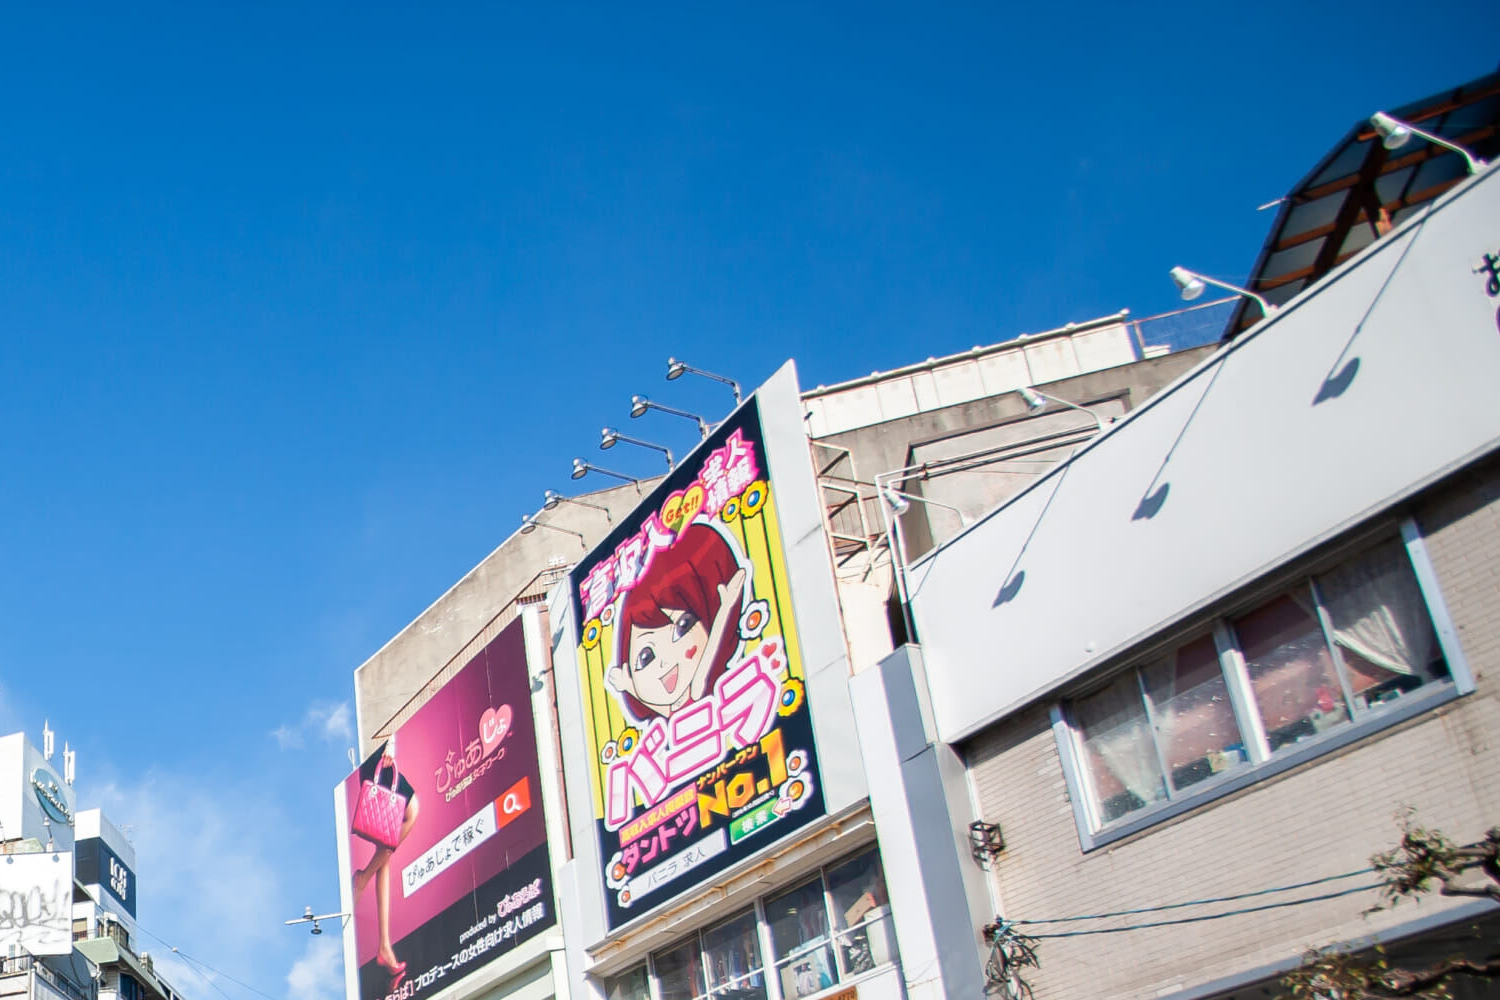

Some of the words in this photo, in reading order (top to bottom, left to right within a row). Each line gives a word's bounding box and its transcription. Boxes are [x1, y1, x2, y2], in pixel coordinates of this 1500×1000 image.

[582, 516, 675, 621] 高収入
[608, 655, 777, 827] バニラ
[697, 745, 759, 790] ナンバーワン
[407, 818, 485, 886] ぴゅあじょで稼ぐ
[622, 805, 697, 874] ダントツ
[648, 861, 677, 889] バニラ
[683, 847, 706, 866] 求人
[415, 902, 545, 991] プロデュースの女性向け求人情報
[459, 919, 487, 944] produced
[488, 913, 497, 925] by
